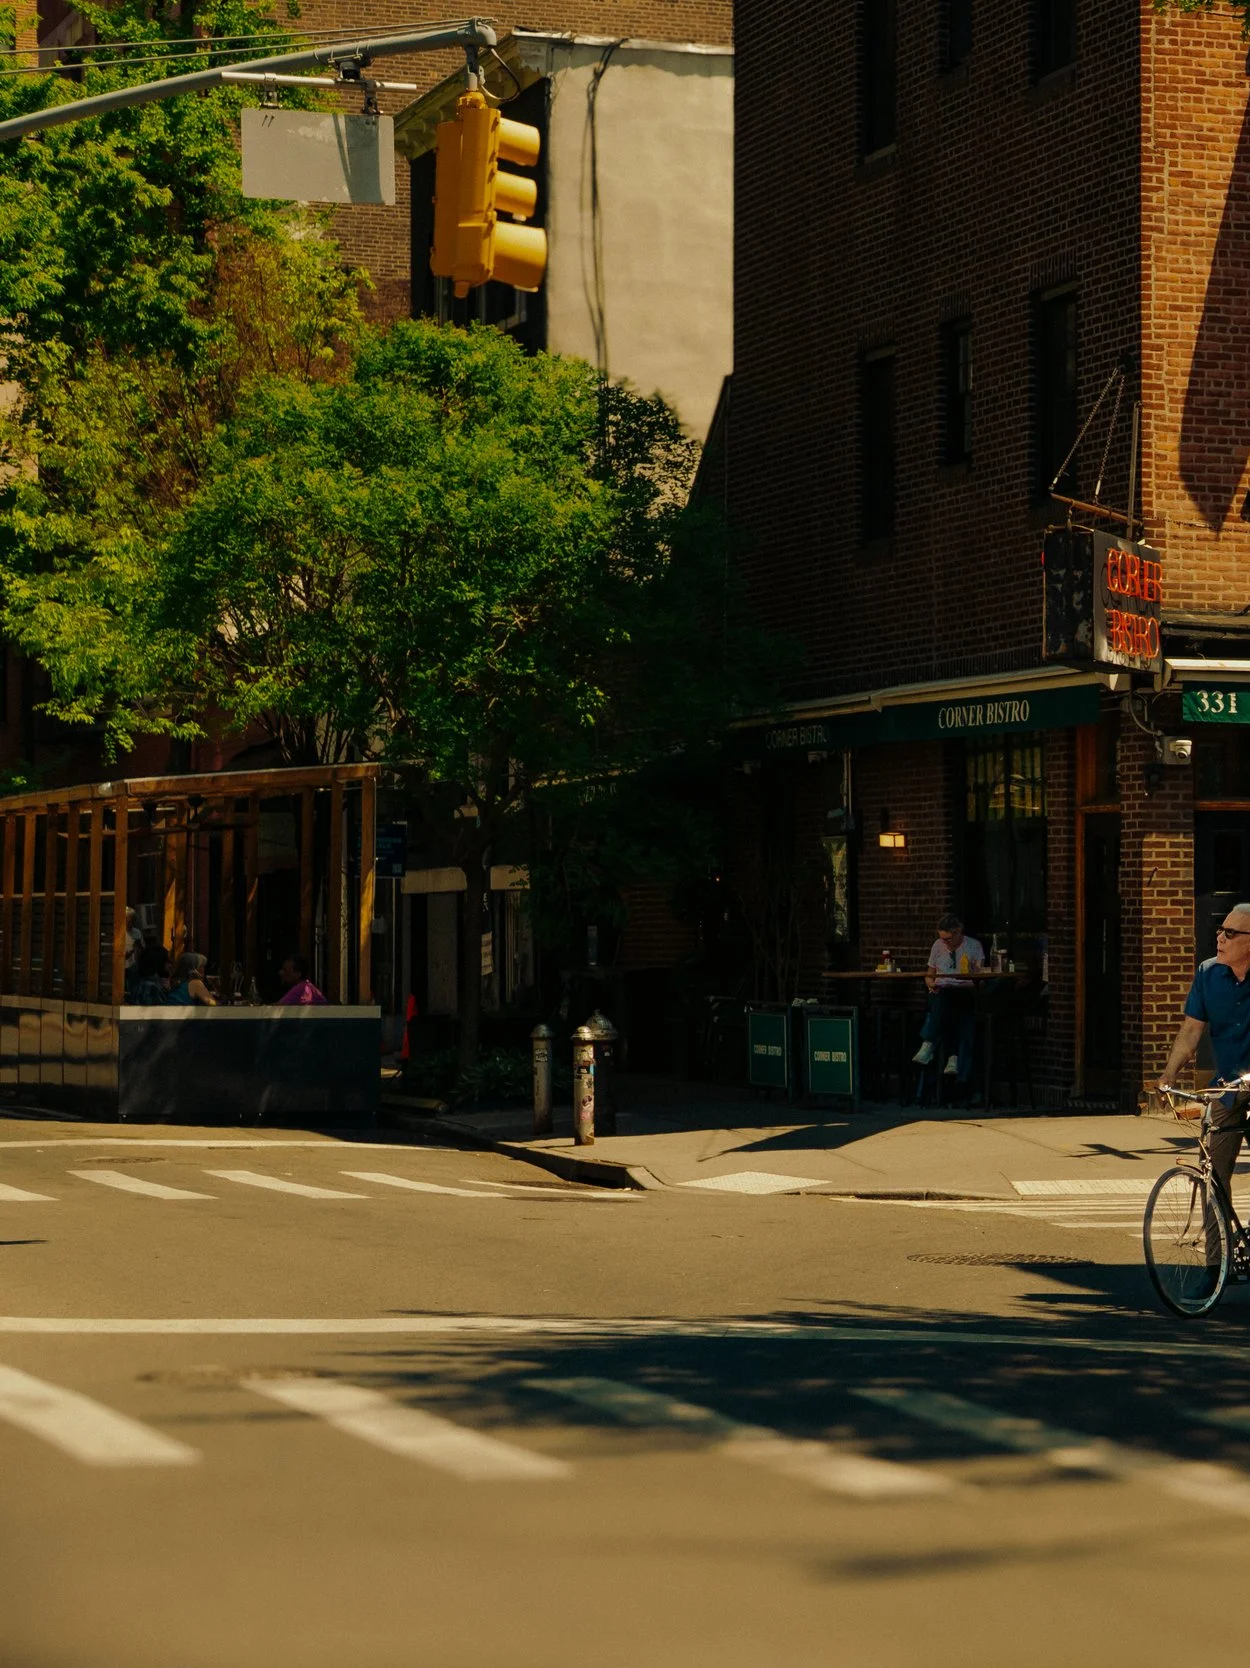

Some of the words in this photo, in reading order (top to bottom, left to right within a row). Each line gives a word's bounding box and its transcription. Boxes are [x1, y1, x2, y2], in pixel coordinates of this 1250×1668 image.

[1107, 548, 1163, 602] CORNER
[1110, 608, 1160, 659] BISTRO
[938, 704, 984, 729] CORNER
[986, 699, 1030, 725] BISTRO
[1197, 690, 1238, 714] 331
[765, 727, 798, 750] CORNER
[799, 724, 829, 745] BISTRO
[814, 1051, 831, 1062] CORNER
[831, 1051, 847, 1063] BISTRO
